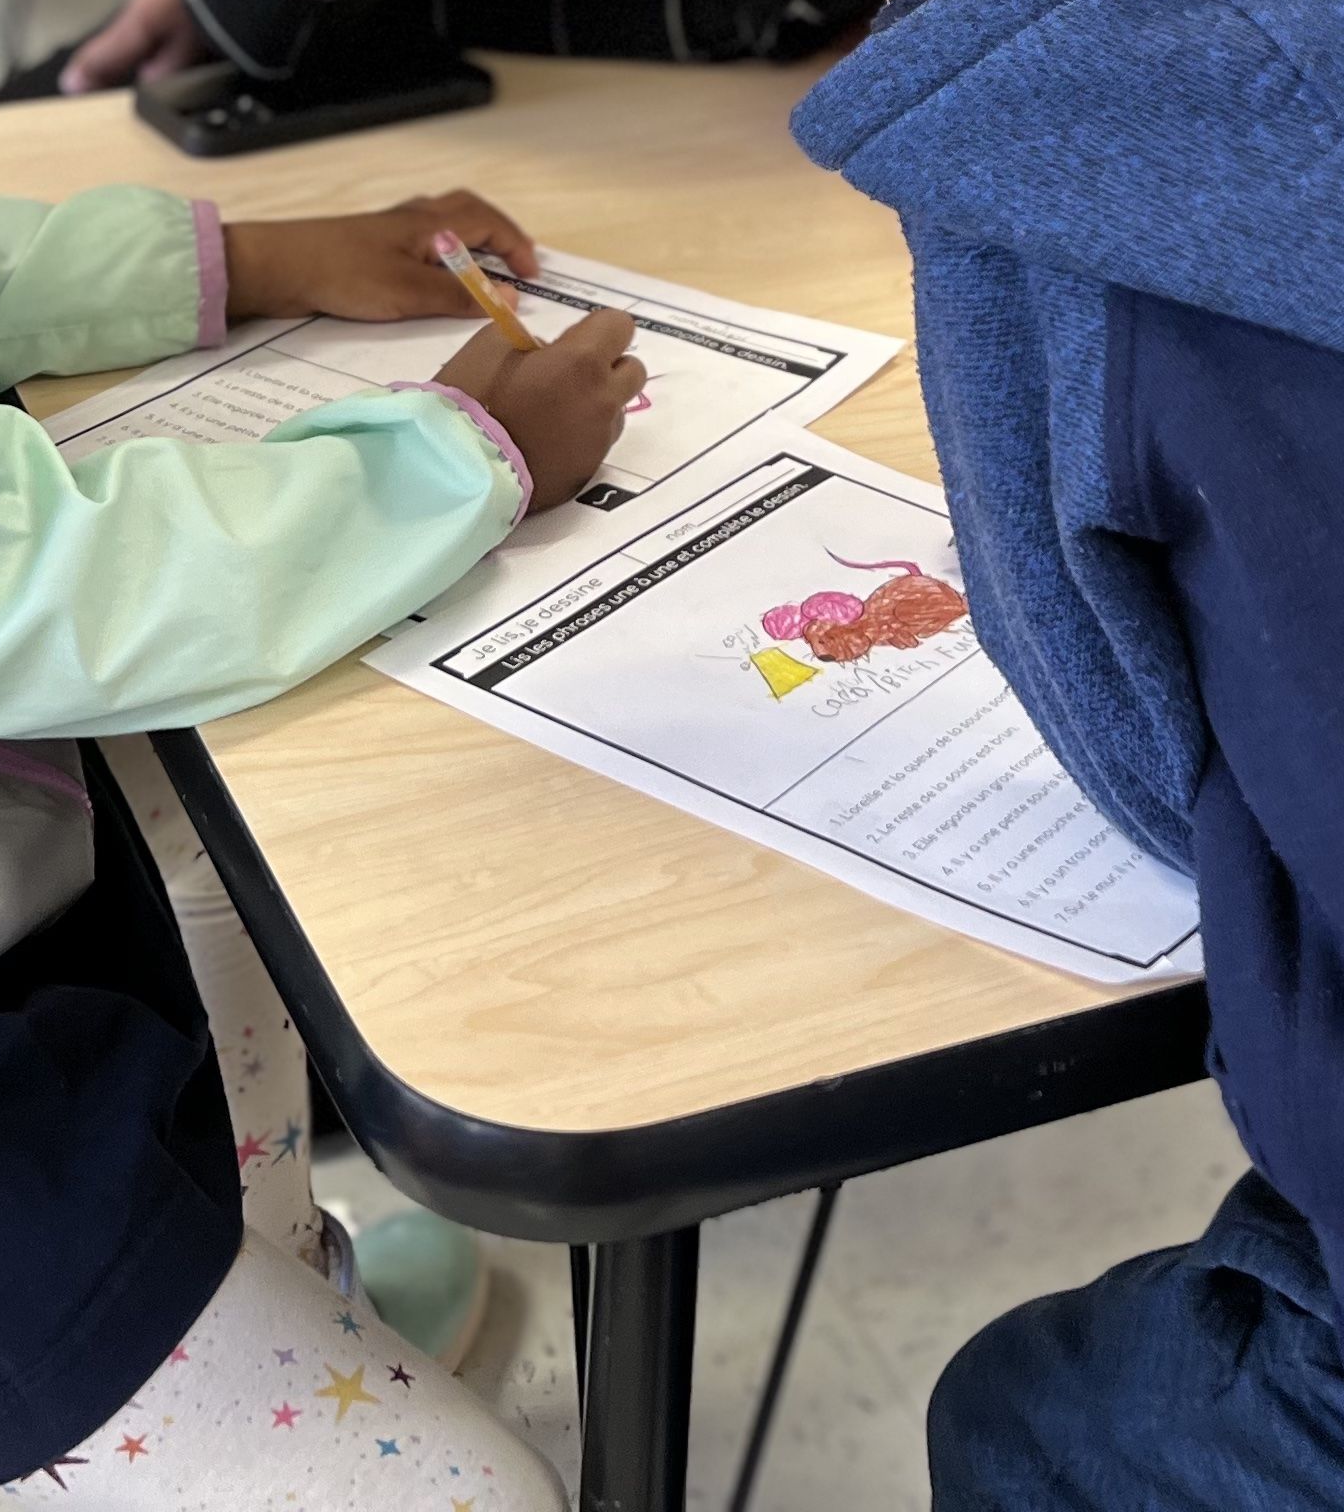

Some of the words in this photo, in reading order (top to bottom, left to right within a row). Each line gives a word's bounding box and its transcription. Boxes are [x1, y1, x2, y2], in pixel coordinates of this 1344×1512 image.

[651, 323, 720, 348] complète
[719, 343, 736, 354] le
[665, 521, 698, 542] nom
[471, 642, 497, 661] Je
[490, 628, 526, 647] lis,
[516, 616, 540, 634] je
[537, 576, 604, 620] dessine
[500, 650, 533, 671] Lis
[526, 637, 555, 656] les
[551, 601, 613, 644] phrases
[607, 582, 640, 606] une
[633, 576, 653, 591] à
[647, 558, 680, 582] une
[675, 548, 697, 564] et
[691, 513, 754, 555] complète
[745, 504, 767, 518] le
[881, 778, 896, 792] et
[903, 745, 939, 774] queue
[934, 733, 954, 749] de
[958, 706, 993, 730] souris
[875, 820, 897, 837] Le
[892, 799, 924, 825] reste
[945, 755, 979, 783] souris
[934, 800, 977, 836] regarde
[973, 788, 993, 803] un
[1025, 779, 1061, 806] souris
